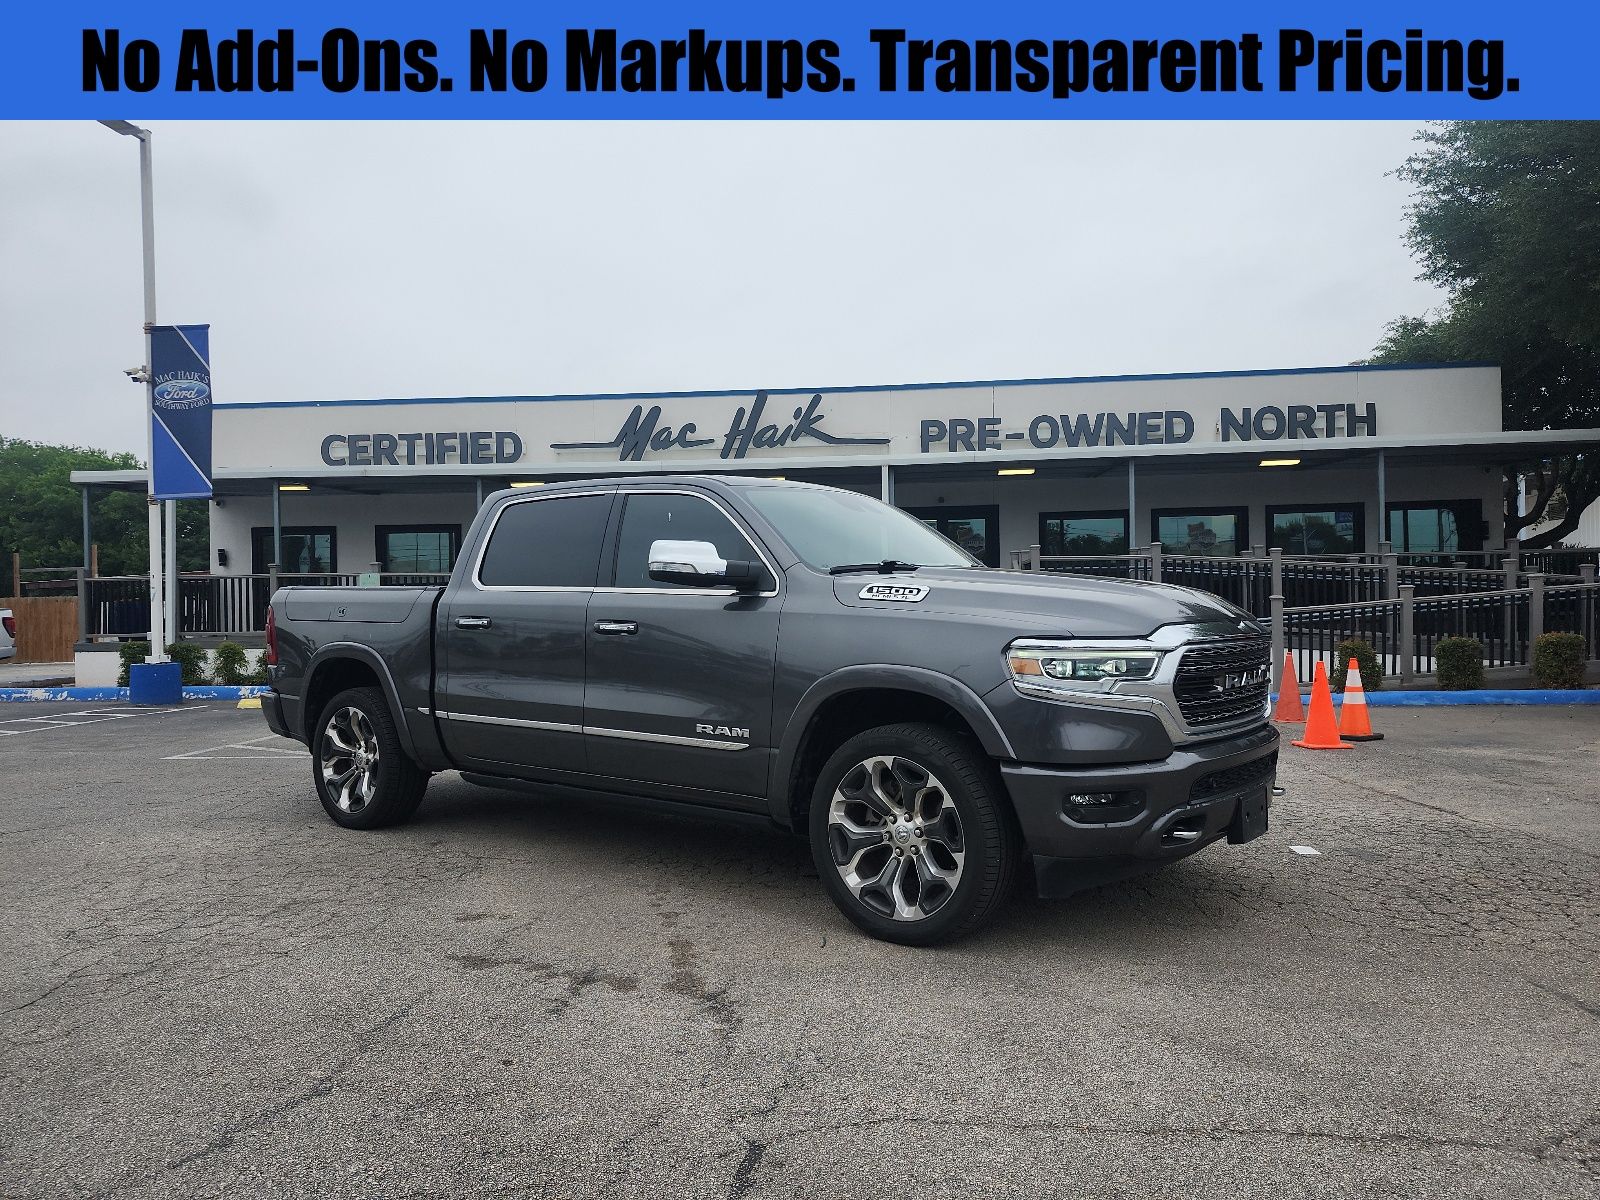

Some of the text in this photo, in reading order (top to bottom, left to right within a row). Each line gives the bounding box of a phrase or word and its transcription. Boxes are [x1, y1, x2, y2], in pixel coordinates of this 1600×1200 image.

[154, 370, 210, 385] MAC HAIK'S
[163, 384, 199, 400] Ford
[154, 398, 210, 410] SOUTHWAY FORD
[320, 389, 1377, 466] CERTIFIED Mac Haik PRE-OWNED NORTH
[872, 586, 918, 595] 1500
[1225, 669, 1264, 689] RAM
[696, 723, 750, 739] RAM
